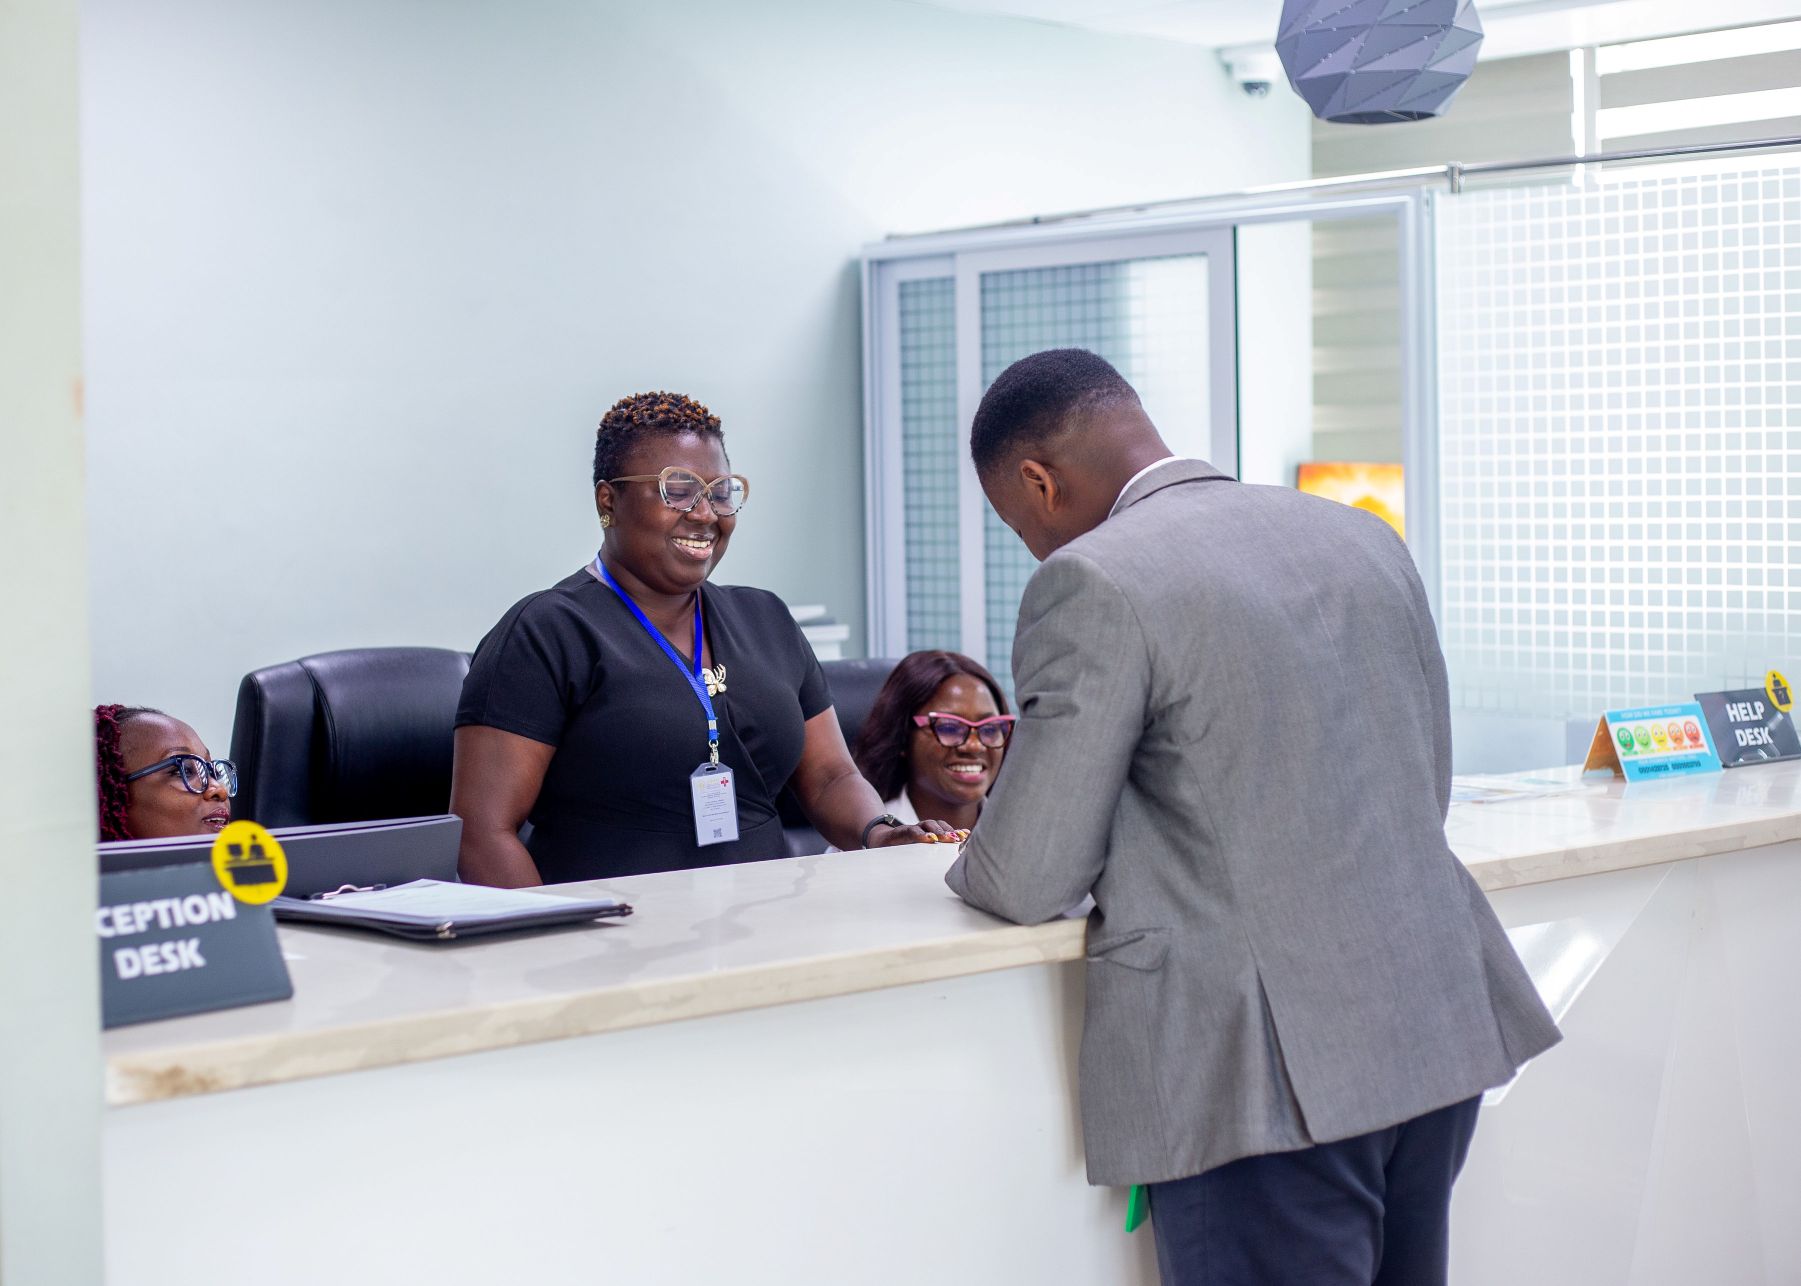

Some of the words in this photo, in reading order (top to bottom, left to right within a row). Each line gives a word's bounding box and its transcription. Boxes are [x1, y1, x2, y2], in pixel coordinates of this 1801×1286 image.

[1725, 701, 1765, 722] HELP
[1735, 727, 1774, 747] DESK
[95, 891, 237, 938] CEPTION
[113, 938, 206, 980] DESK
